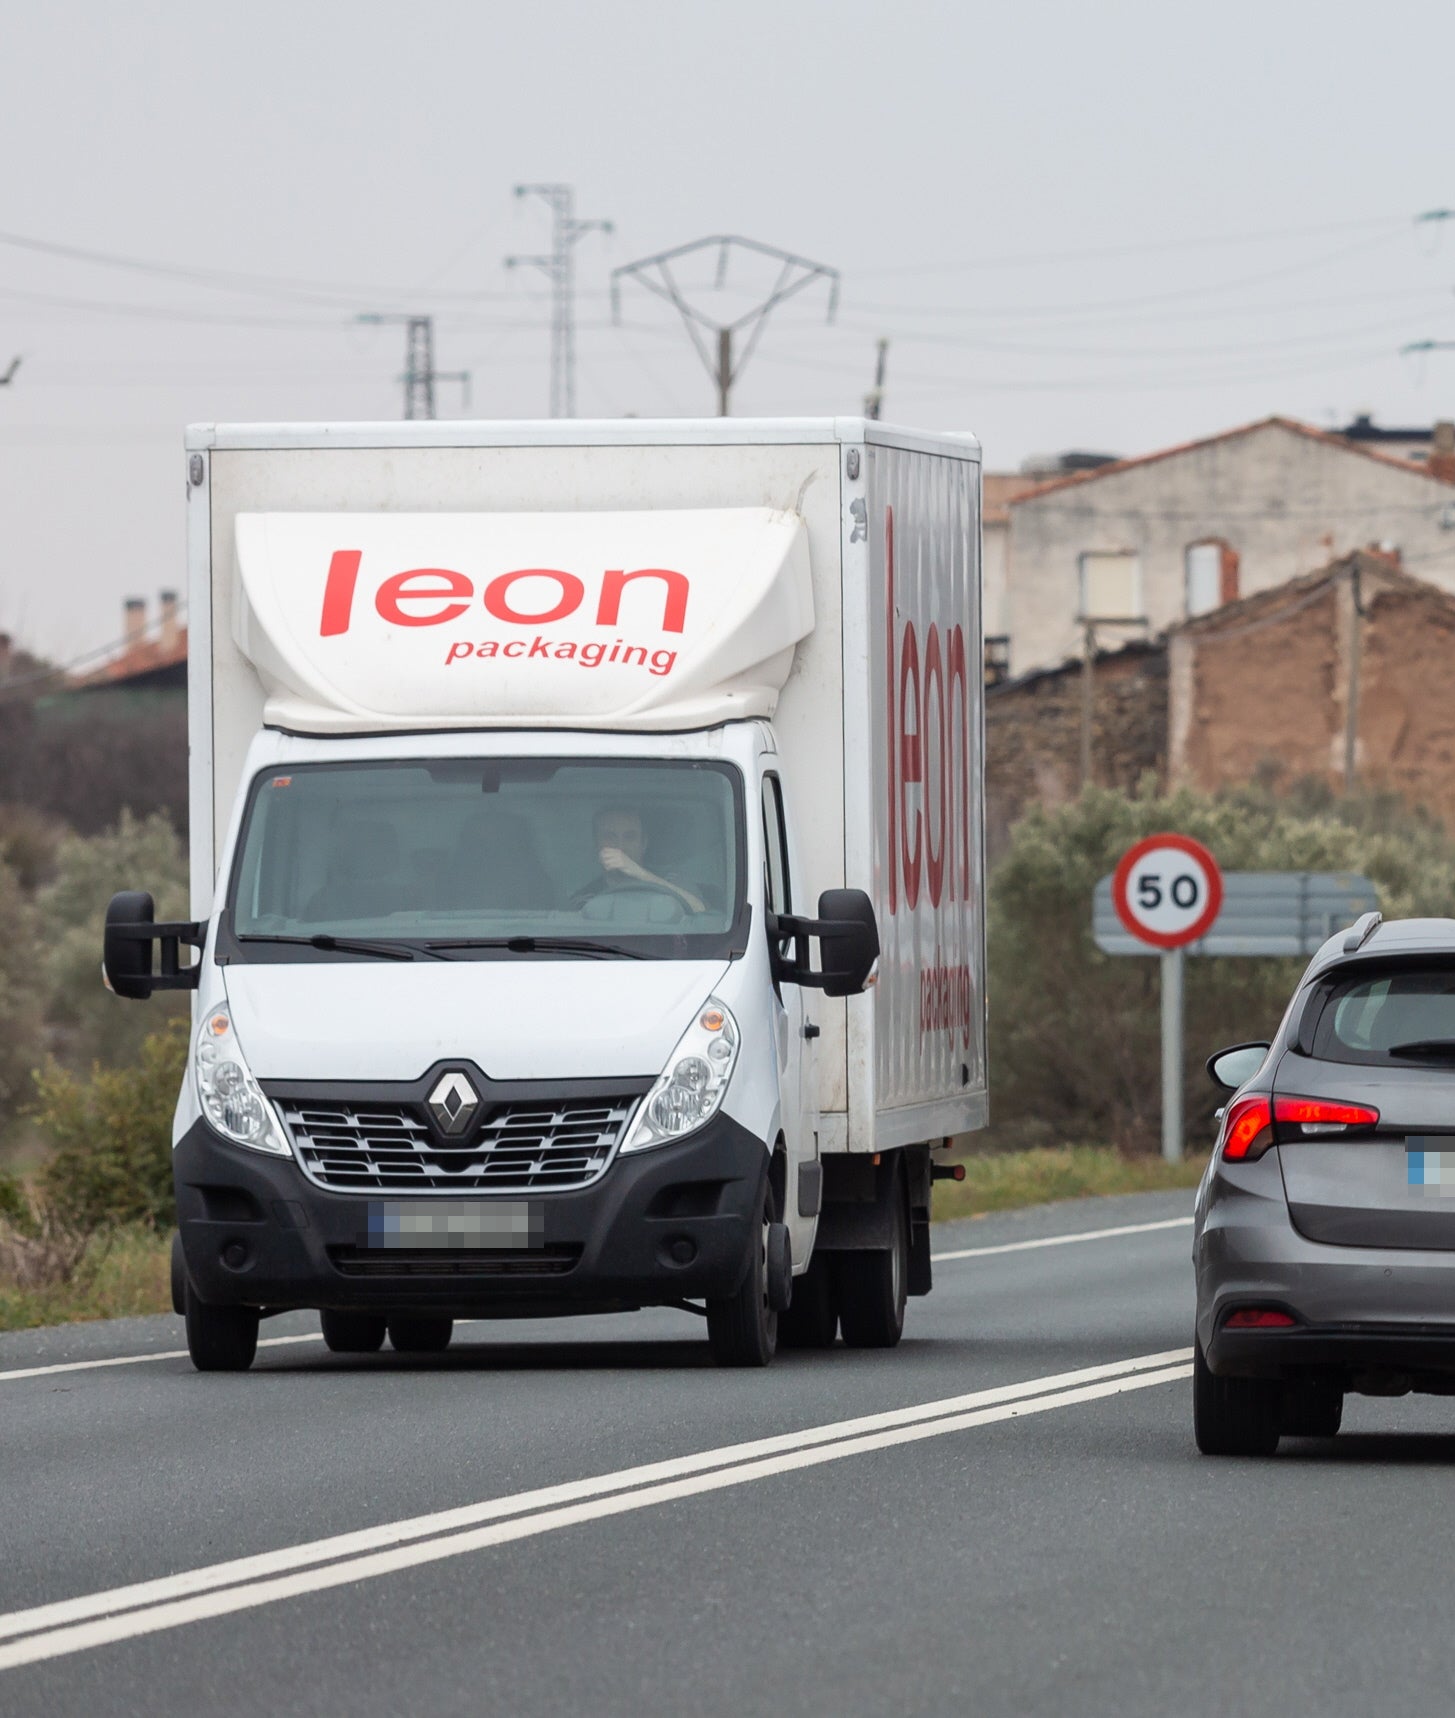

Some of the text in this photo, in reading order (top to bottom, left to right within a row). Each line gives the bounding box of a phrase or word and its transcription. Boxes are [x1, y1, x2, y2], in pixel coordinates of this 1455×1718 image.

[318, 549, 691, 638] leon
[445, 636, 678, 677] packaging
[885, 504, 970, 917] leon
[1138, 875, 1199, 910] 50
